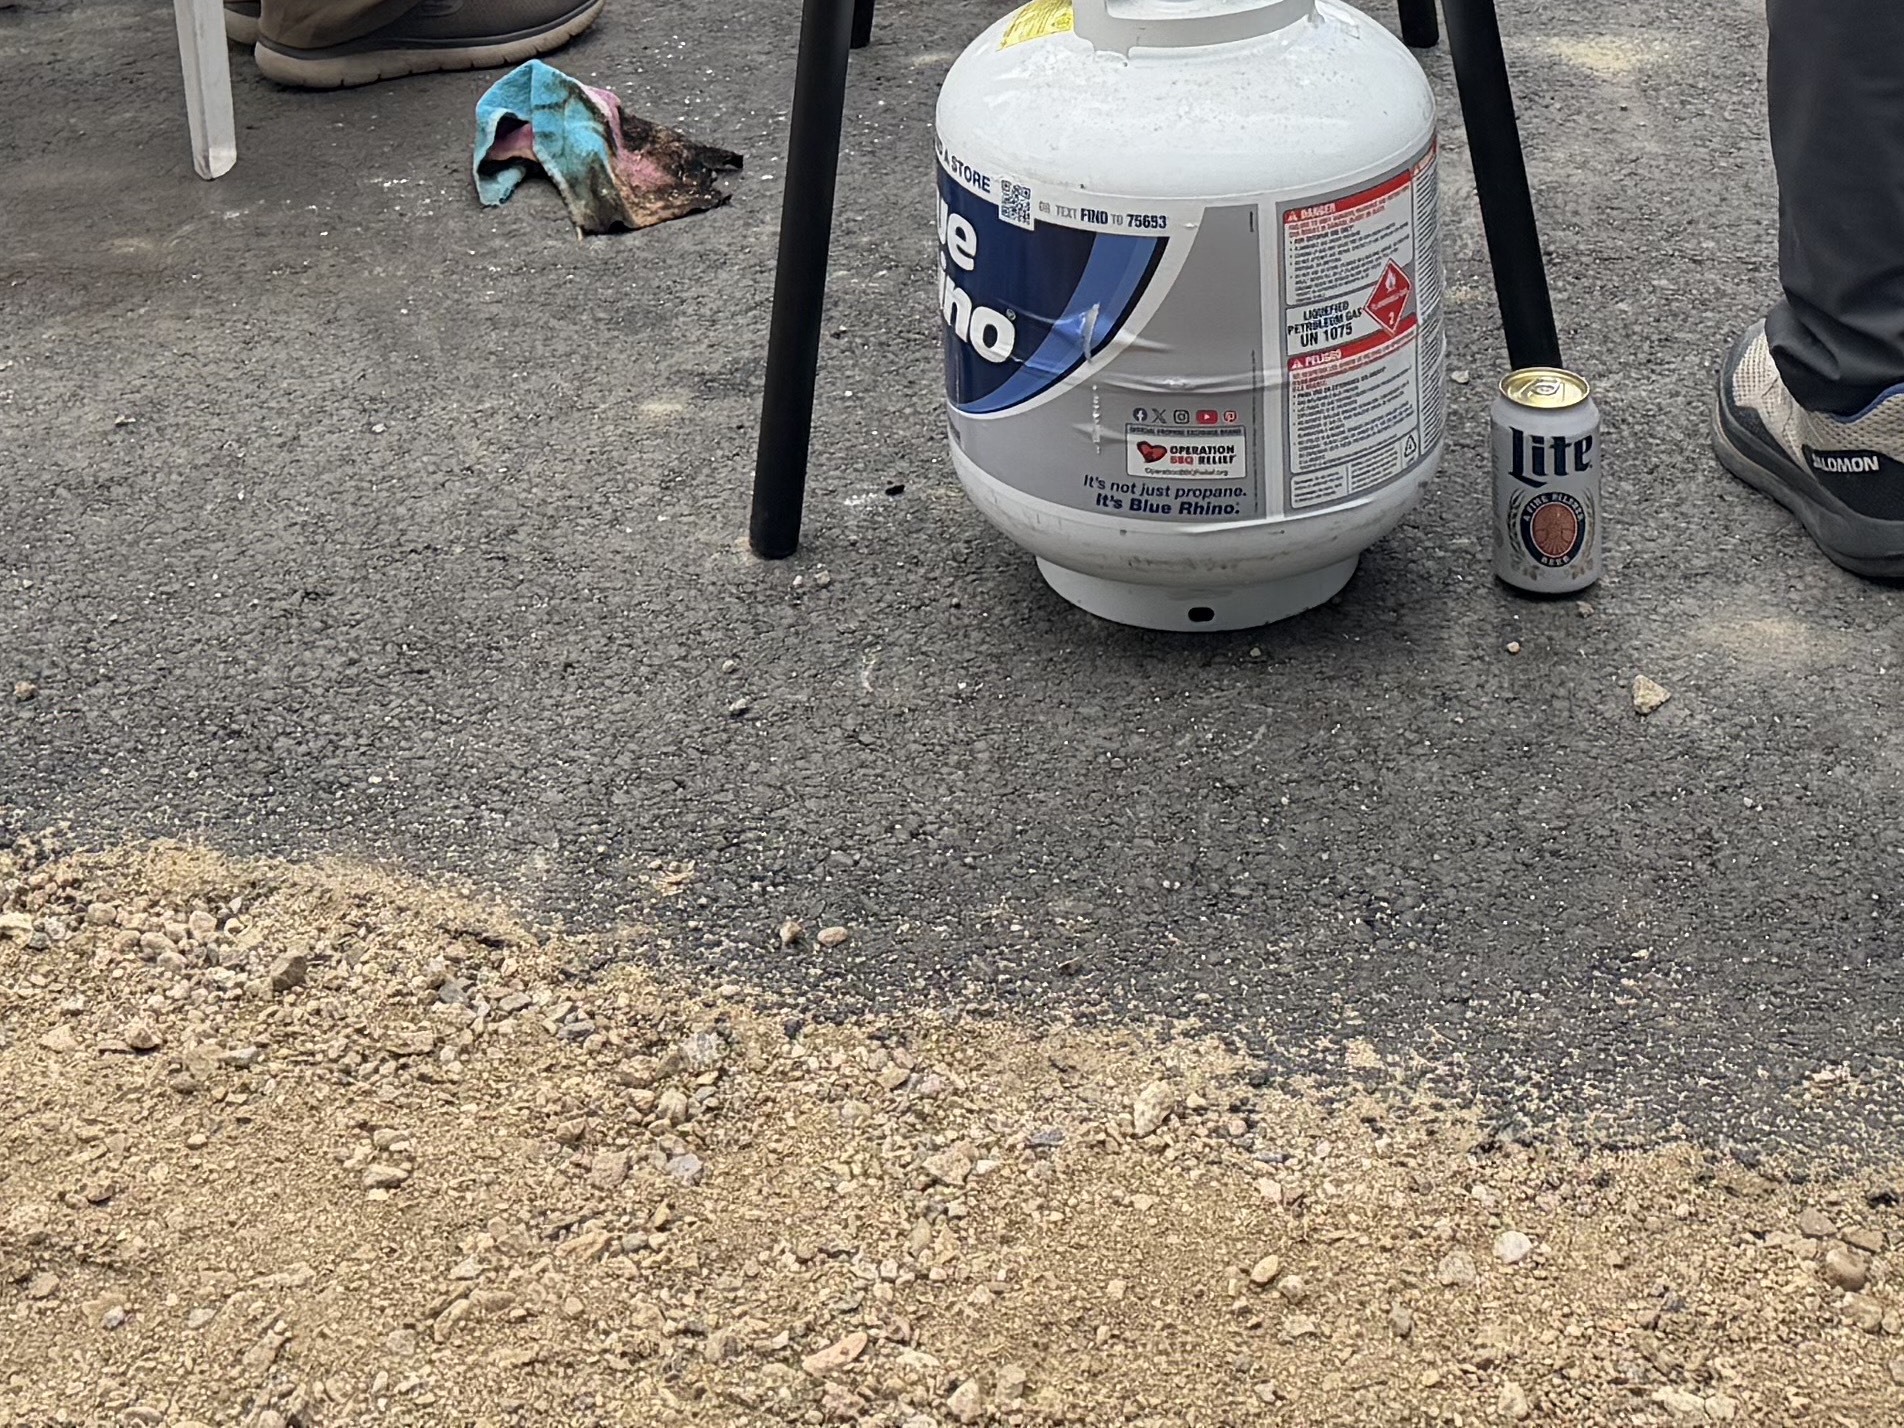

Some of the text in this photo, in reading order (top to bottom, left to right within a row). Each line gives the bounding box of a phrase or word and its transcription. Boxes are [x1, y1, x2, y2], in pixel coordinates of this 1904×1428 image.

[951, 155, 991, 194] STORE
[1055, 205, 1077, 219] TEXT
[1080, 208, 1109, 225] FIND
[1111, 214, 1124, 225] TO
[1300, 322, 1353, 348] UN 1075
[1169, 445, 1235, 456] OPERATION
[1198, 455, 1236, 465] RELIEF
[1508, 426, 1594, 489] Lite
[1083, 474, 1247, 501] It's not just propane.
[1095, 492, 1123, 510] It's
[1129, 497, 1172, 515] Blue
